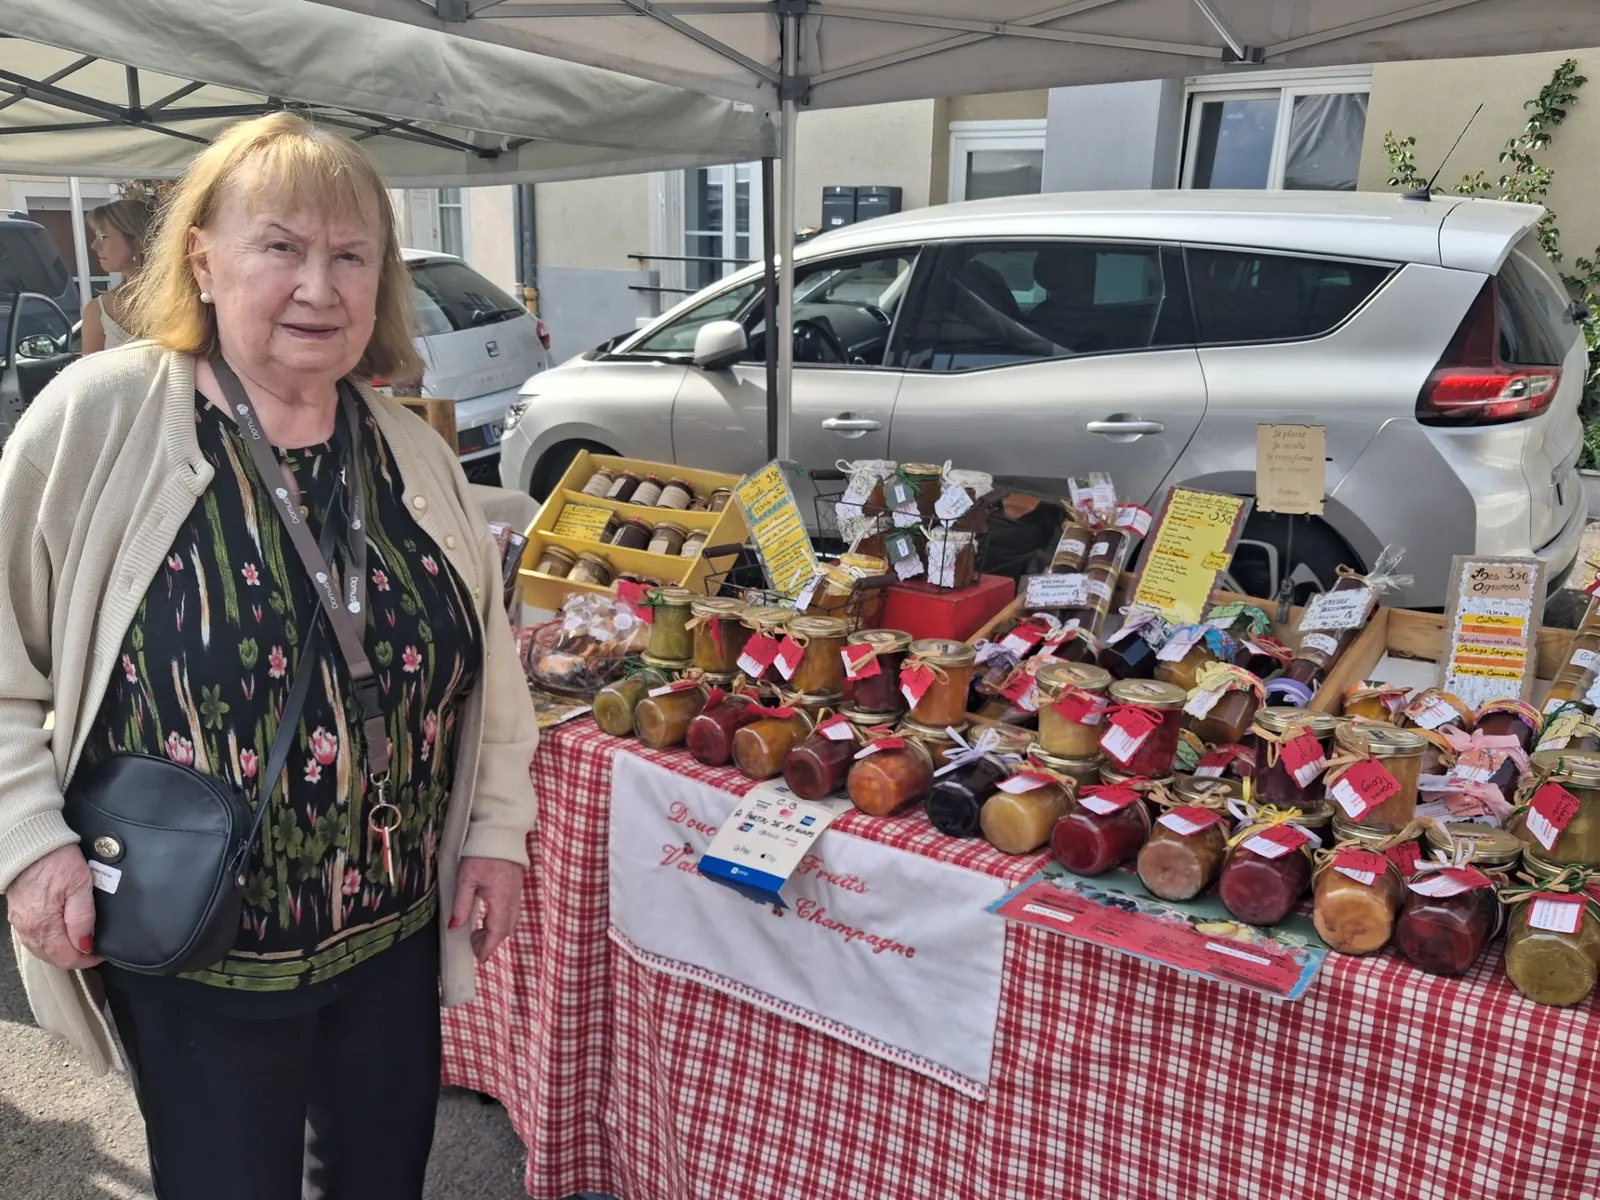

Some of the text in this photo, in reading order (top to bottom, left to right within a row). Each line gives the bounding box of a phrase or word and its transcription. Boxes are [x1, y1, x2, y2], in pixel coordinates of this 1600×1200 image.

[244, 413, 260, 440] Domus
[1273, 430, 1307, 440] Je plante
[1265, 453, 1314, 463] Je transforme
[1272, 442, 1280, 450] Je
[284, 498, 300, 525] Domus
[324, 581, 339, 610] Domus
[350, 576, 359, 603] Domus
[1476, 616, 1509, 624] Citron
[1456, 644, 1523, 657] Orange Sanguine
[1453, 665, 1485, 676] Orange
[667, 801, 718, 836] Douc
[796, 854, 870, 894] Fruits
[796, 898, 916, 959] Champagne
